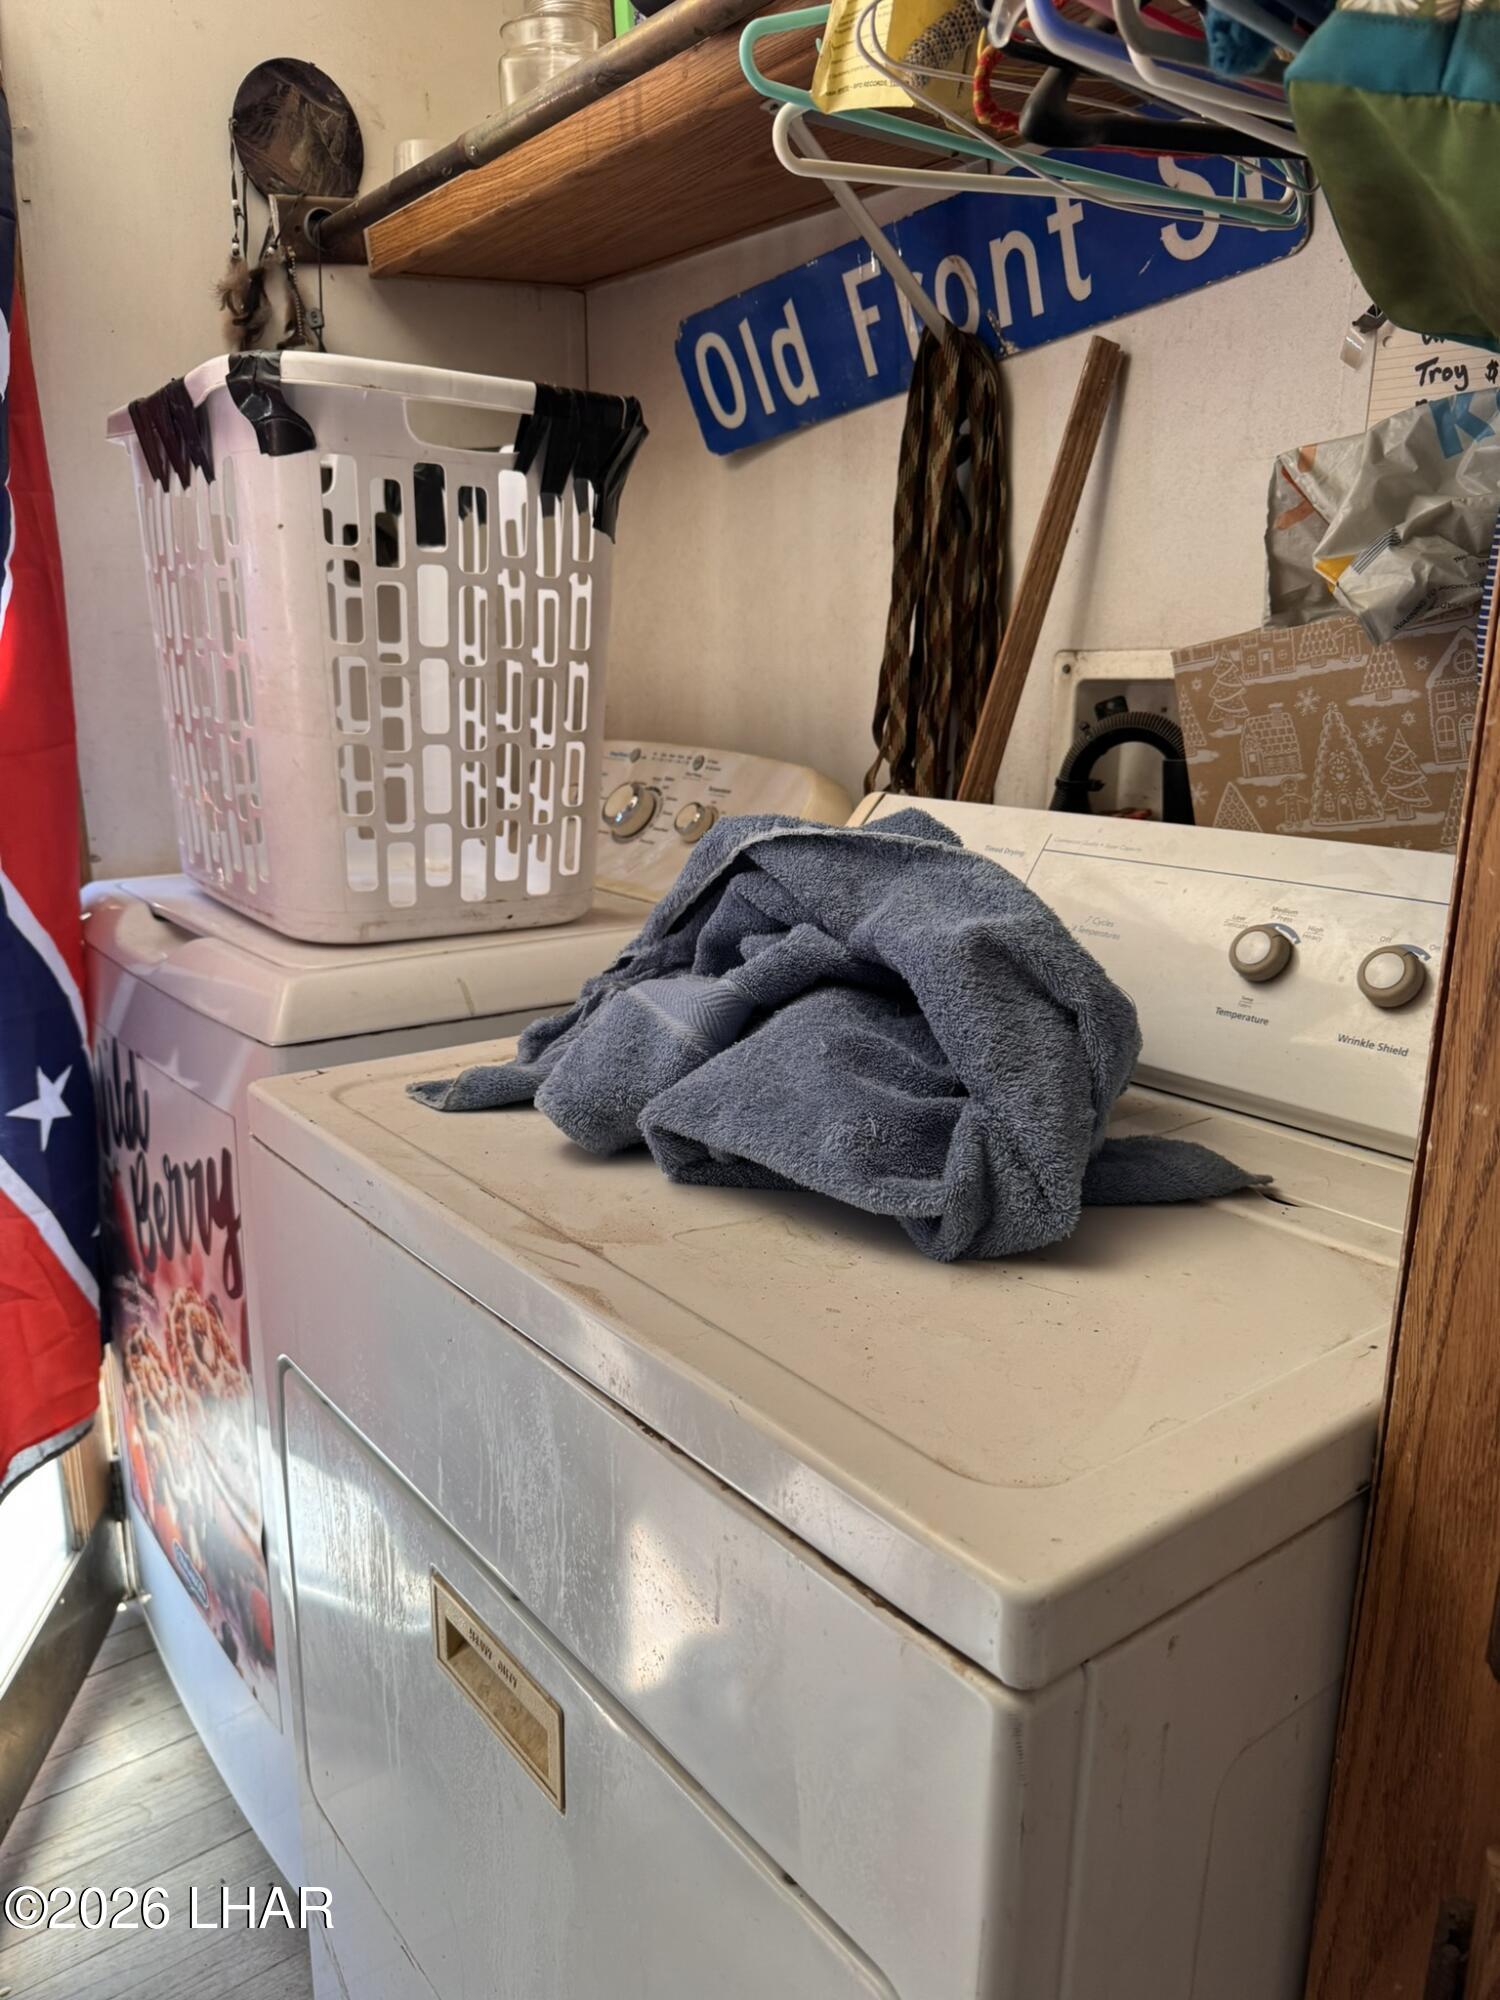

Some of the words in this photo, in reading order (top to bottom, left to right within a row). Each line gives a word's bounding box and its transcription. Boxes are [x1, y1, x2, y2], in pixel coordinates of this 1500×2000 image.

[694, 300, 820, 430] Old
[1415, 356, 1469, 391] Troy
[1231, 914, 1246, 922] Low
[1271, 905, 1299, 916] Medium
[1092, 917, 1114, 928] Cycles
[1307, 925, 1324, 934] High
[1215, 1006, 1270, 1026] Temperature
[1337, 1033, 1376, 1051] Wrinkle
[1377, 1042, 1410, 1058] Shield
[130, 1147, 243, 1299] Berry
